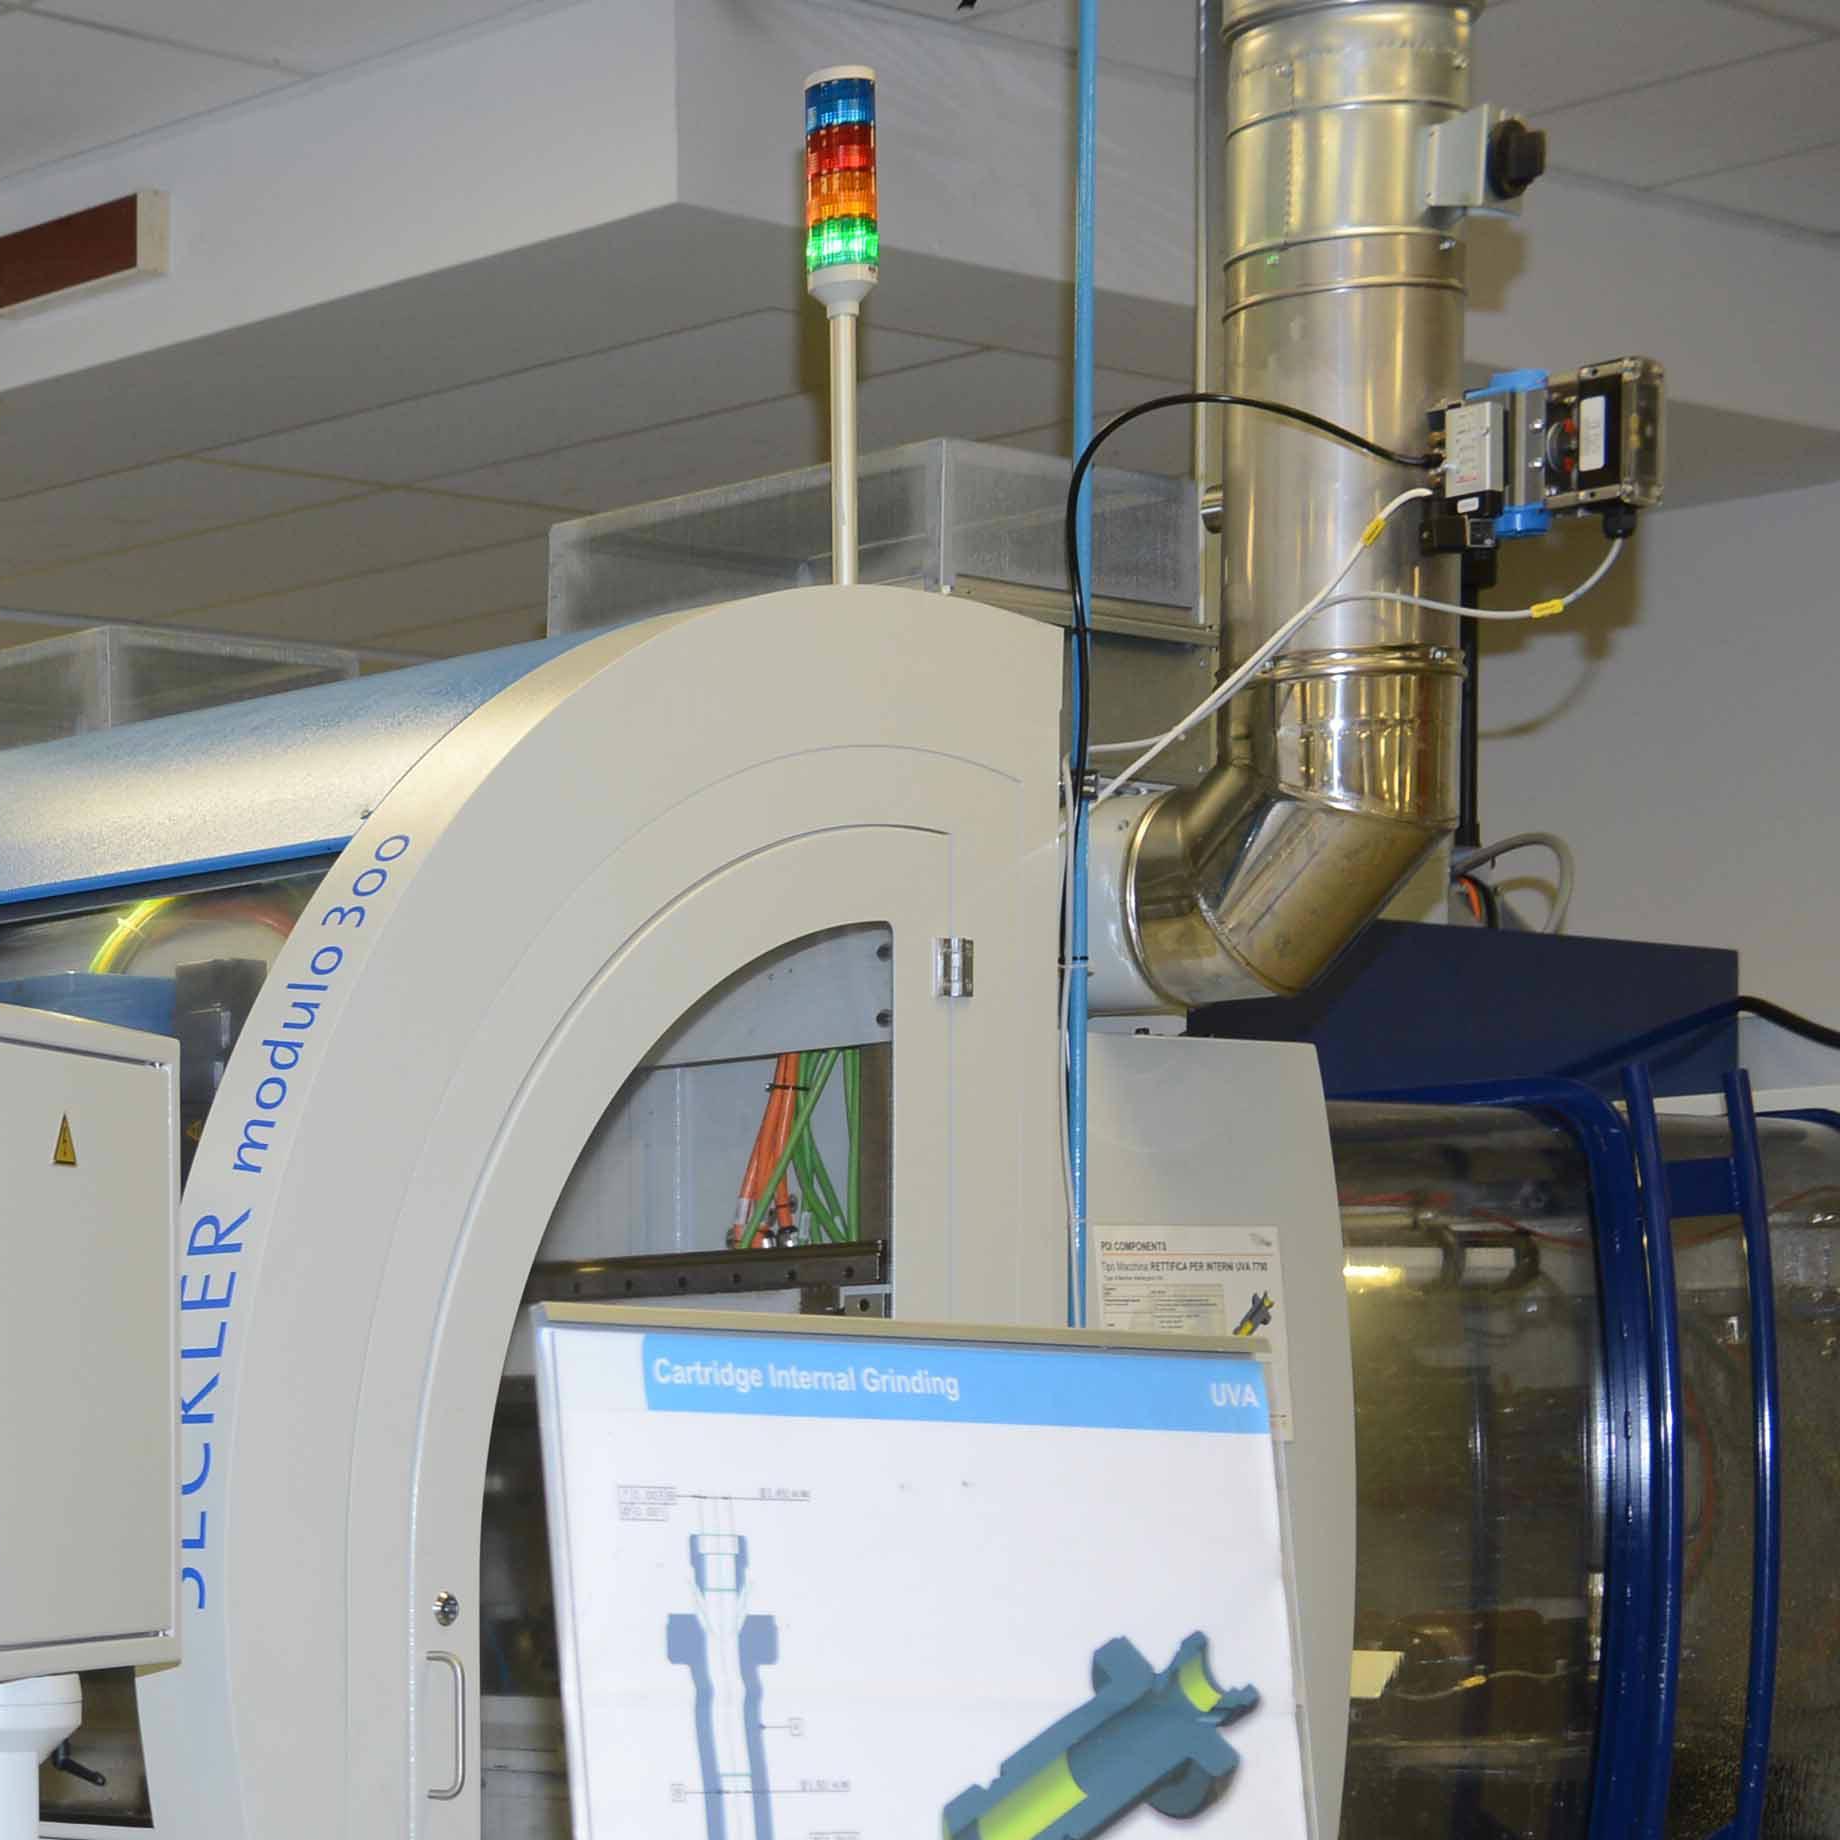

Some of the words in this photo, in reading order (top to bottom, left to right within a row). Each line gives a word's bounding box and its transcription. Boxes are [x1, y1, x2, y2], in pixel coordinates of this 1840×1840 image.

[233, 943, 344, 1173] modulo
[321, 833, 410, 929] 300
[1114, 1240, 1168, 1253] COMPONENTS
[1150, 1260, 1188, 1272] RETTIFICA
[653, 1357, 763, 1393] Cartridge
[769, 1363, 856, 1392] Internal
[863, 1367, 960, 1401] Grinding
[1209, 1382, 1260, 1408] UVA
